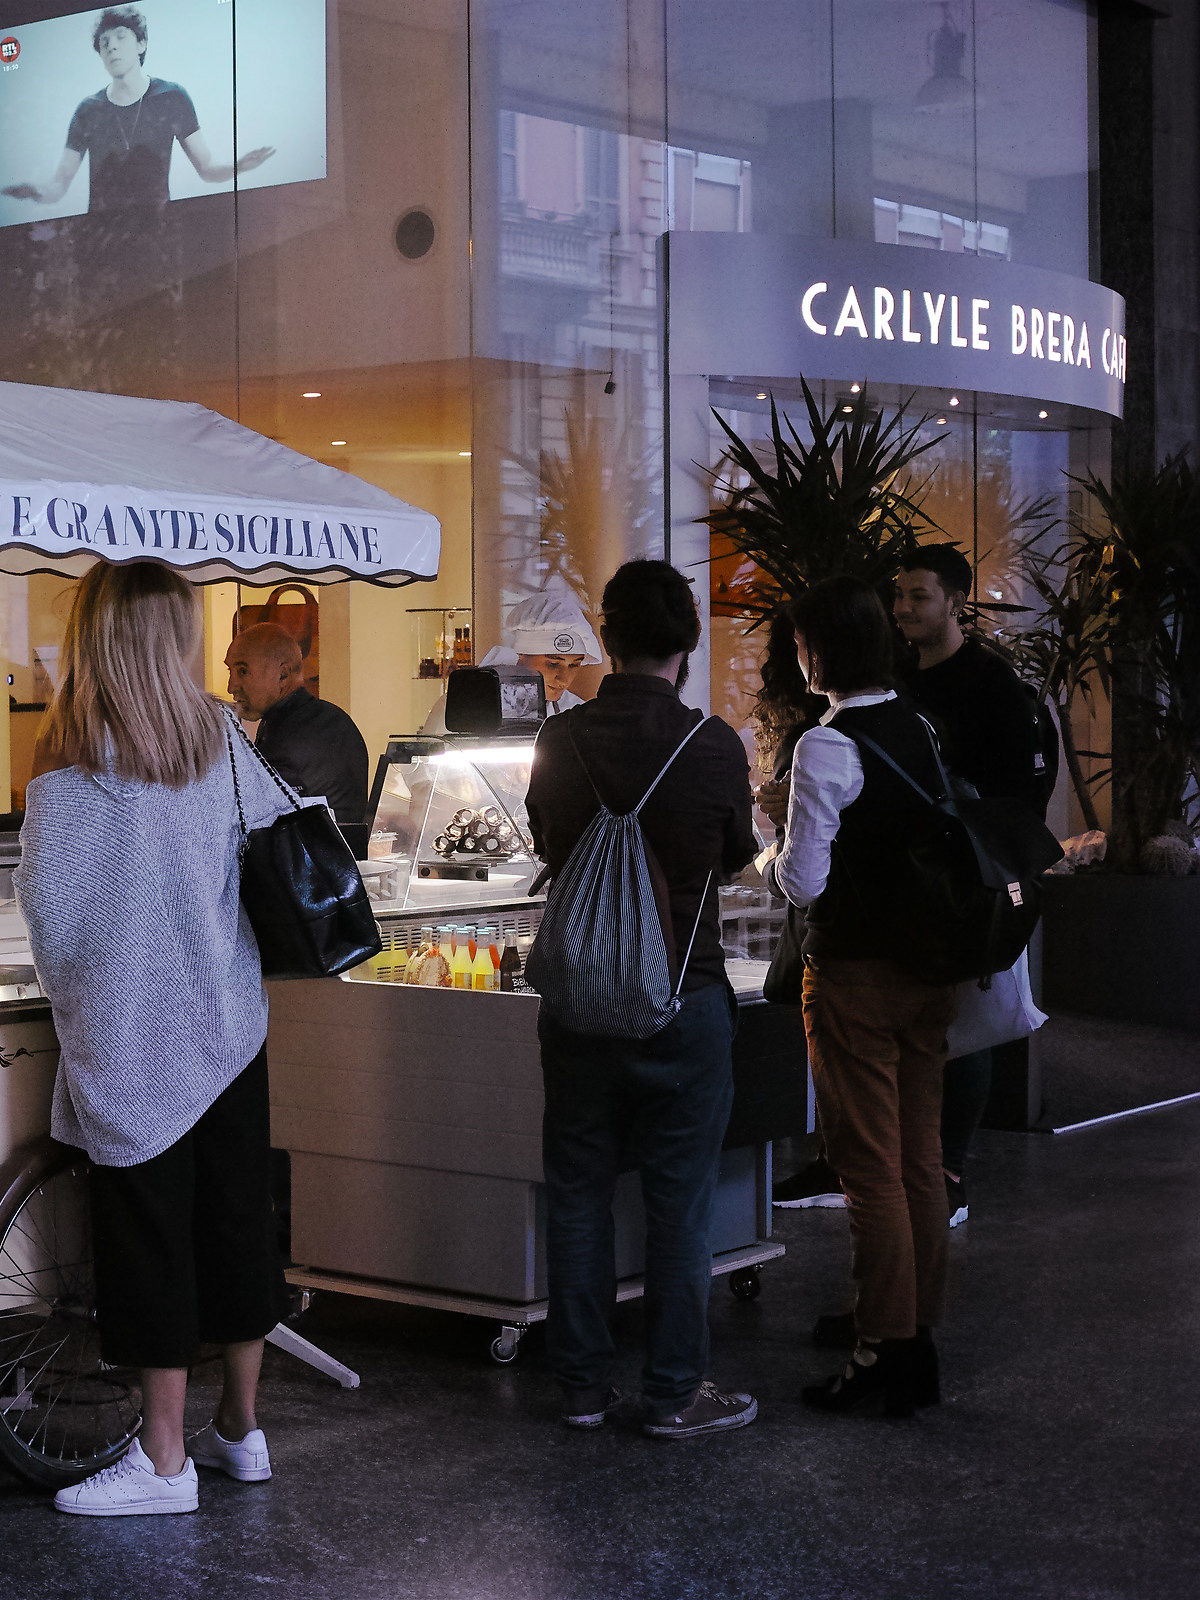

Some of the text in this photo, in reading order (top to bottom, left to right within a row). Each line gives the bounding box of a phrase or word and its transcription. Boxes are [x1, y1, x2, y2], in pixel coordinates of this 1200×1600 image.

[2, 43, 17, 51] RTL
[801, 281, 991, 351] CARLYLE
[1011, 303, 1092, 369] BRERA
[10, 495, 37, 537] E
[46, 497, 209, 551] GRANITE
[214, 513, 382, 565] SICILIANE
